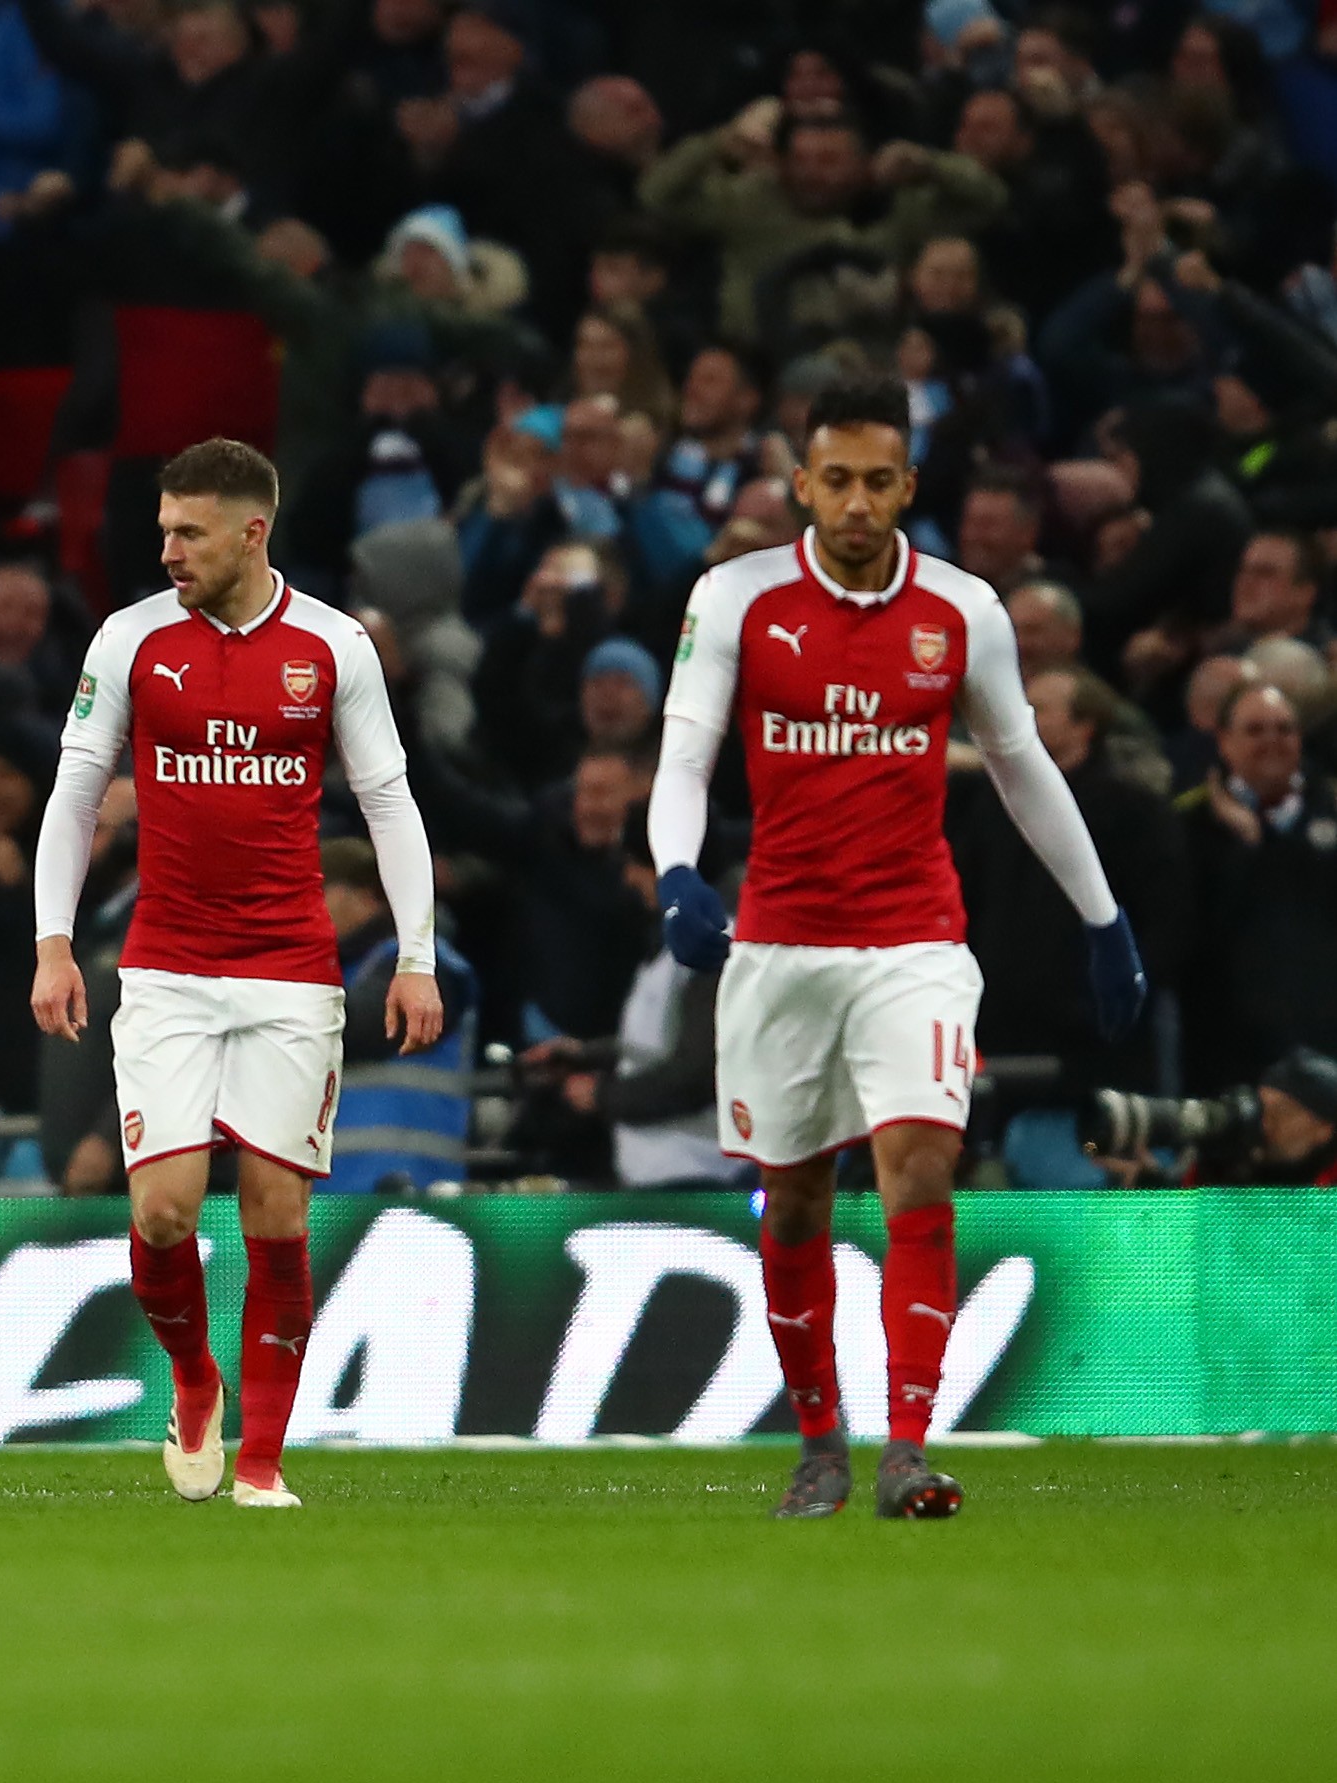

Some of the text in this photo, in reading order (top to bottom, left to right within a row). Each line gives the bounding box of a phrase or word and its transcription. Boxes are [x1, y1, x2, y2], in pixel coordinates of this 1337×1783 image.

[824, 683, 881, 721] Fly
[206, 719, 258, 751] Fly
[762, 710, 931, 756] Emirates
[154, 745, 307, 786] Emirates
[932, 1019, 972, 1089] 14
[317, 1070, 336, 1133] 8
